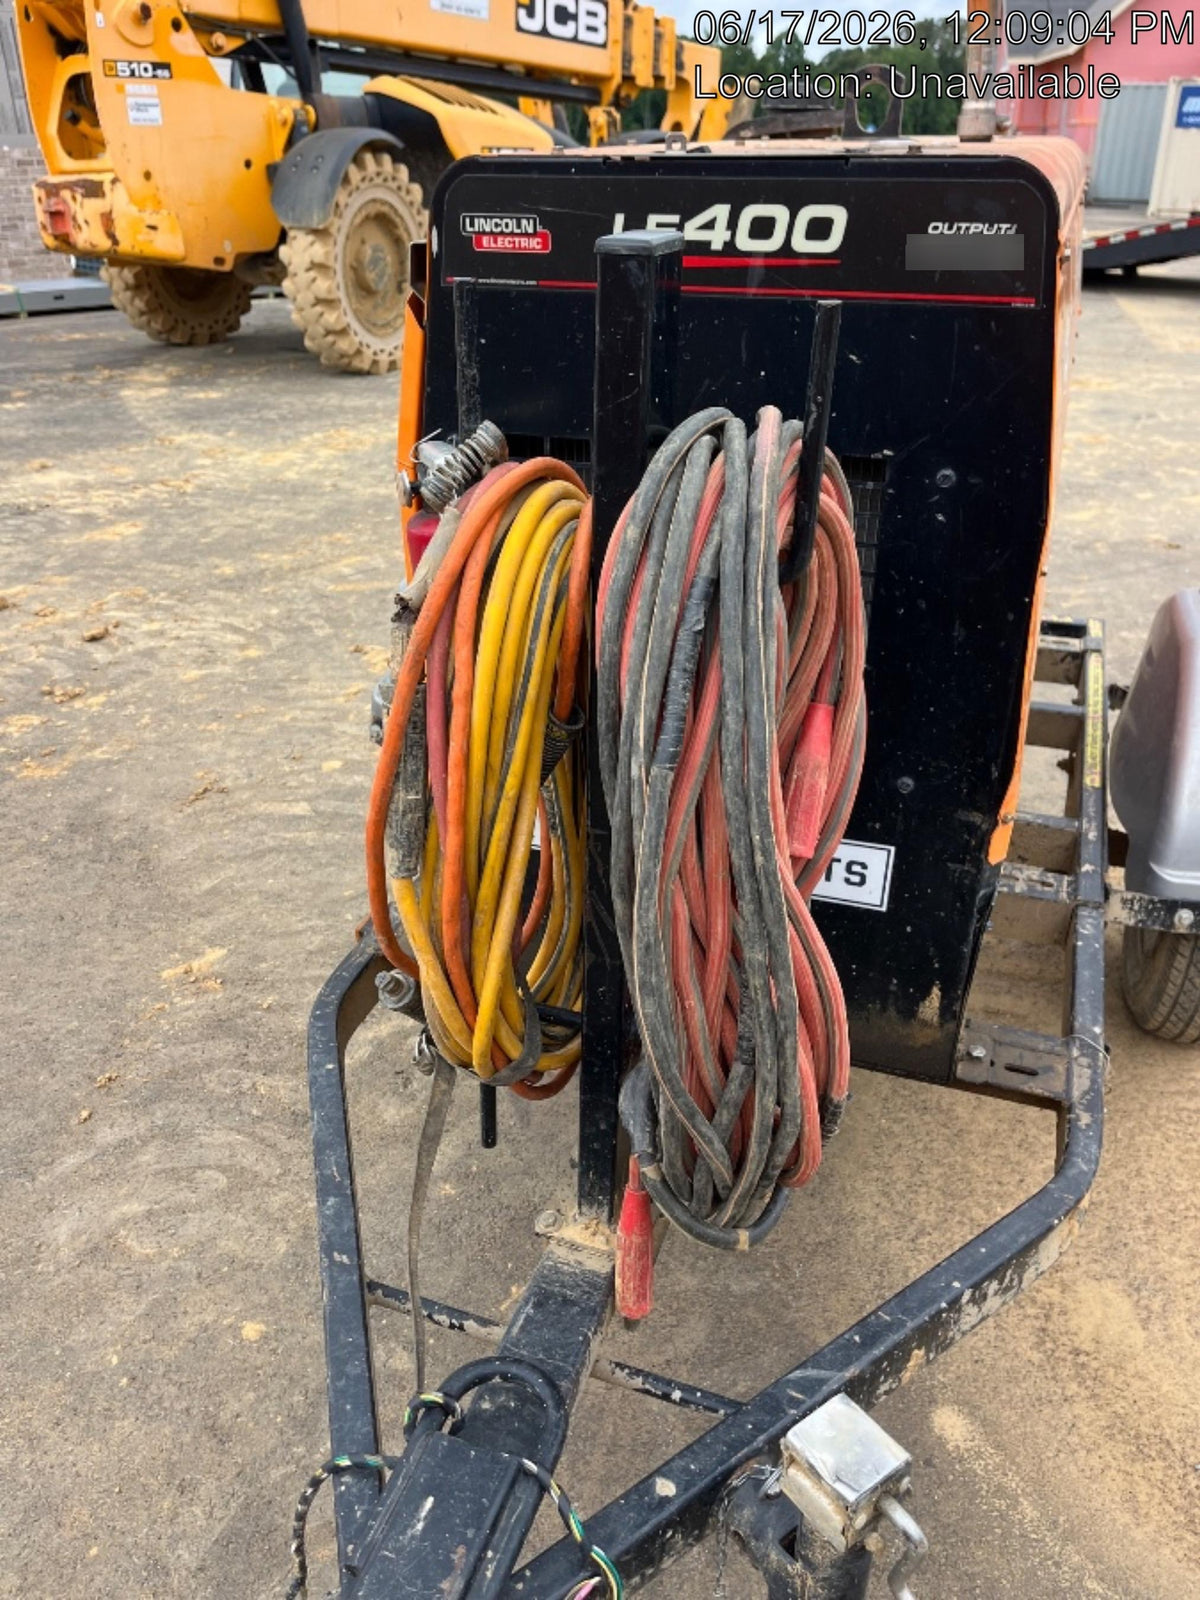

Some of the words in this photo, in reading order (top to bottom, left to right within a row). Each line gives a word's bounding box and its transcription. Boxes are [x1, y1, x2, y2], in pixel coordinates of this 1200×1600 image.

[517, 0, 608, 45] JCB
[465, 217, 534, 234] LINCOLN
[482, 236, 543, 250] ELECTRIC
